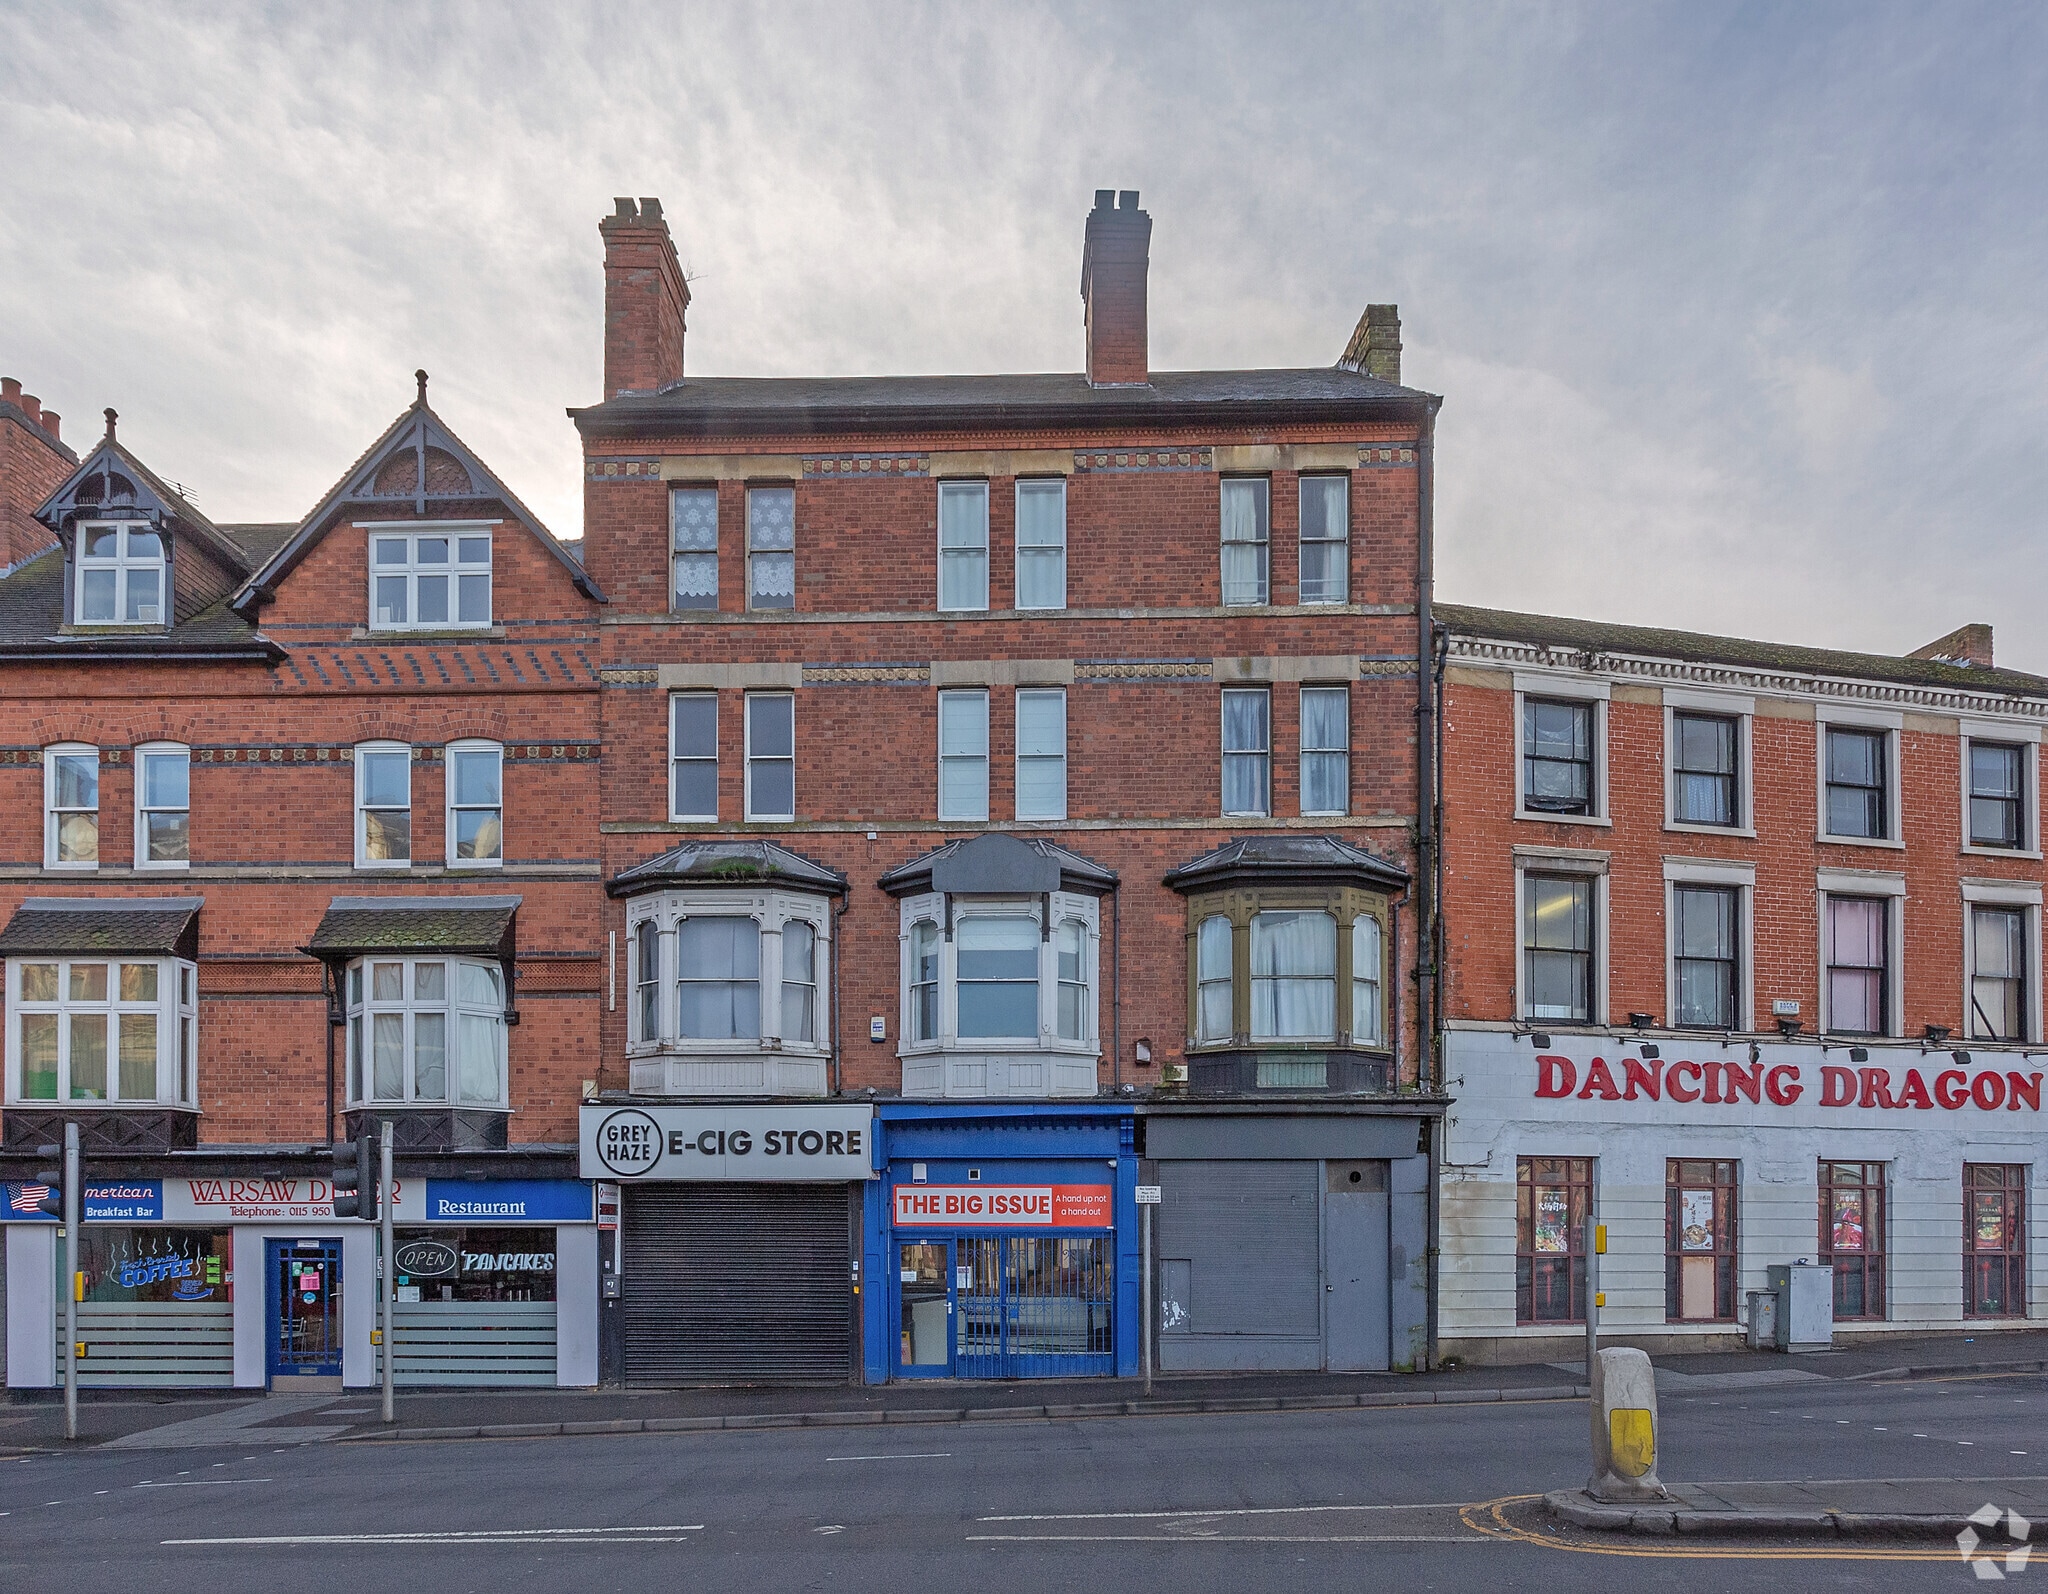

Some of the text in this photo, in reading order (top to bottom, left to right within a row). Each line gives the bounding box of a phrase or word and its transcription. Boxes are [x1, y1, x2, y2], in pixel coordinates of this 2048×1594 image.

[1535, 1055, 2044, 1112] DANCING DRAGON
[607, 1125, 650, 1142] GREY
[669, 1130, 861, 1155] E-CIG STORE
[607, 1144, 650, 1161] HAZE
[84, 1185, 154, 1199] merican
[188, 1180, 401, 1201] WARSAW DIR
[438, 1199, 526, 1214] Restaurant
[899, 1195, 1050, 1214] THE BIG ISSUE
[1055, 1194, 1107, 1205] A hand up not
[86, 1206, 154, 1217] Breakfast Bar
[230, 1206, 331, 1218] Telephone: 0115 950
[1061, 1207, 1101, 1216] a hand out
[404, 1251, 448, 1266] OPEN
[460, 1250, 555, 1272] PANCAKES
[120, 1259, 193, 1287] COFFEE
